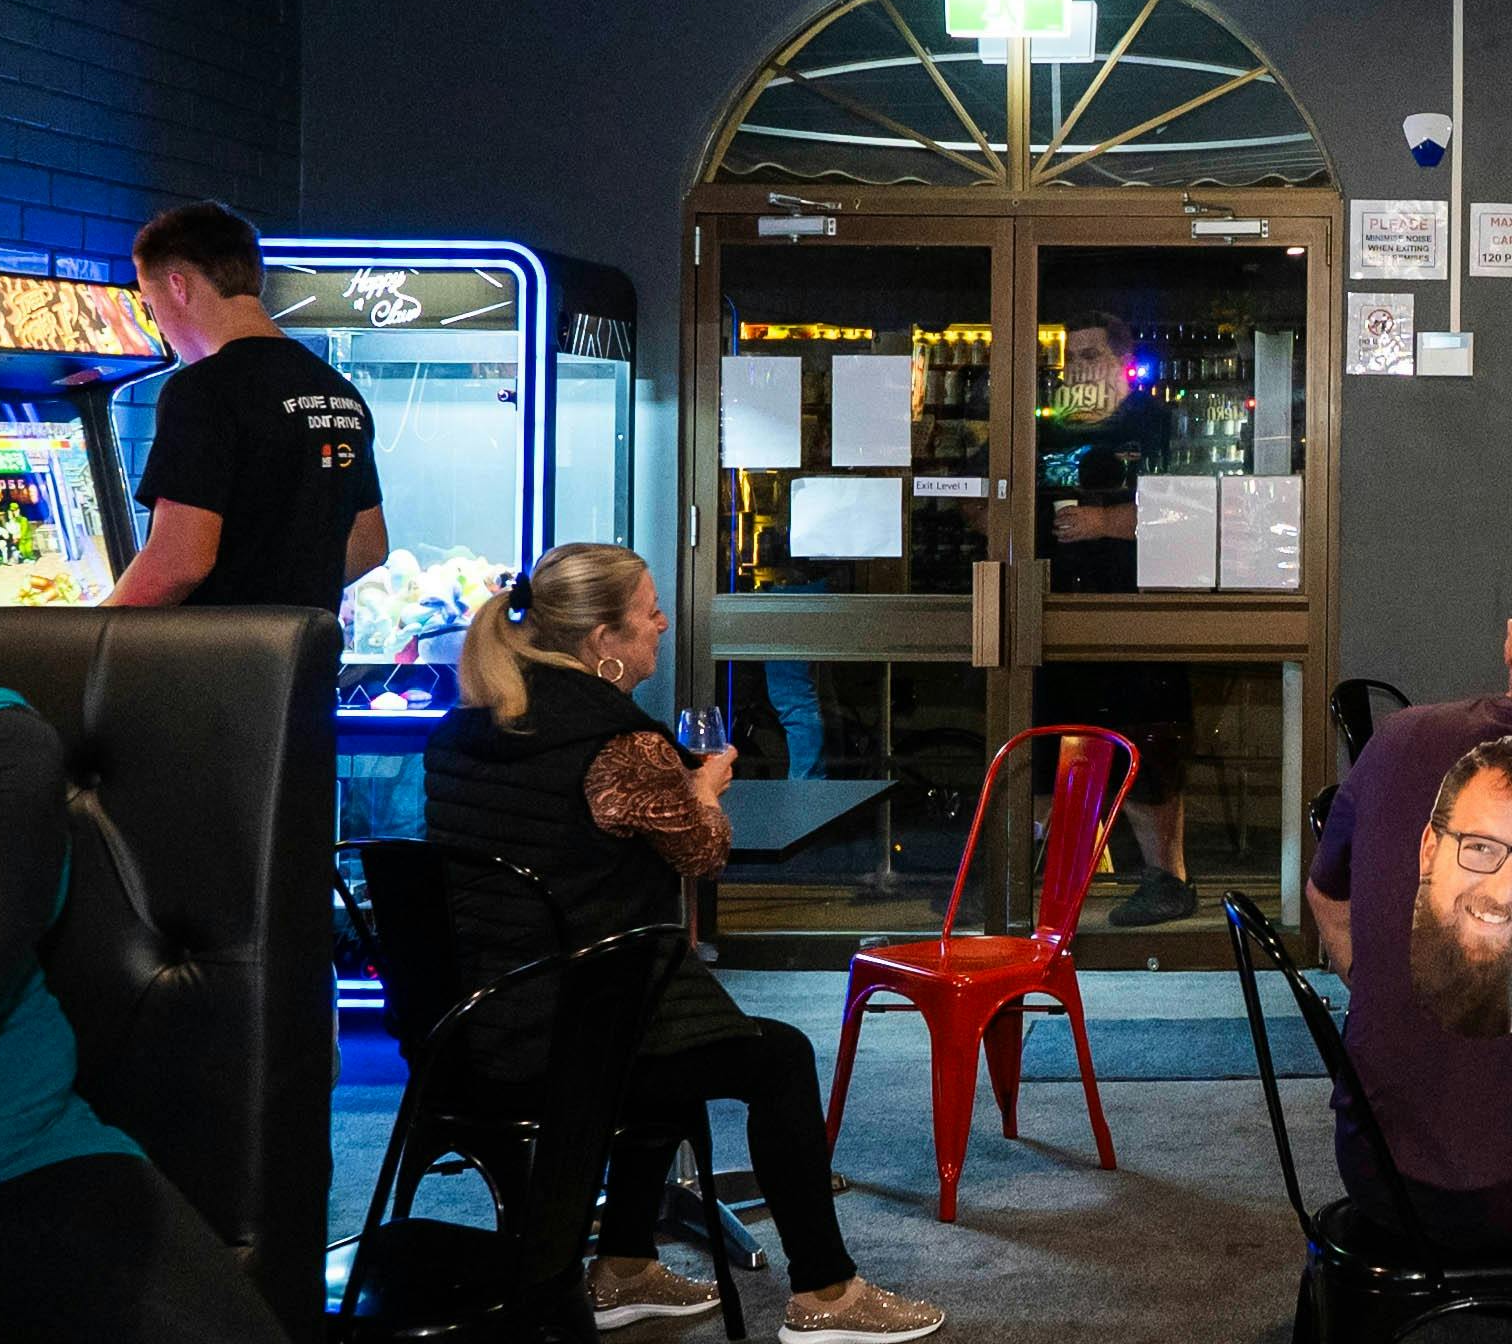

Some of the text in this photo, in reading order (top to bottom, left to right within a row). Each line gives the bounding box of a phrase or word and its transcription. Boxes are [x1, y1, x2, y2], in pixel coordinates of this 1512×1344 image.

[1369, 218, 1429, 231] PLEASE
[1405, 234, 1432, 243] NOISE
[1368, 244, 1430, 253] WHEN EXITING
[1482, 253, 1501, 263] 120
[342, 267, 406, 300] Happy
[370, 297, 422, 327] Claw
[916, 481, 933, 490] Exit
[936, 481, 960, 490] Level
